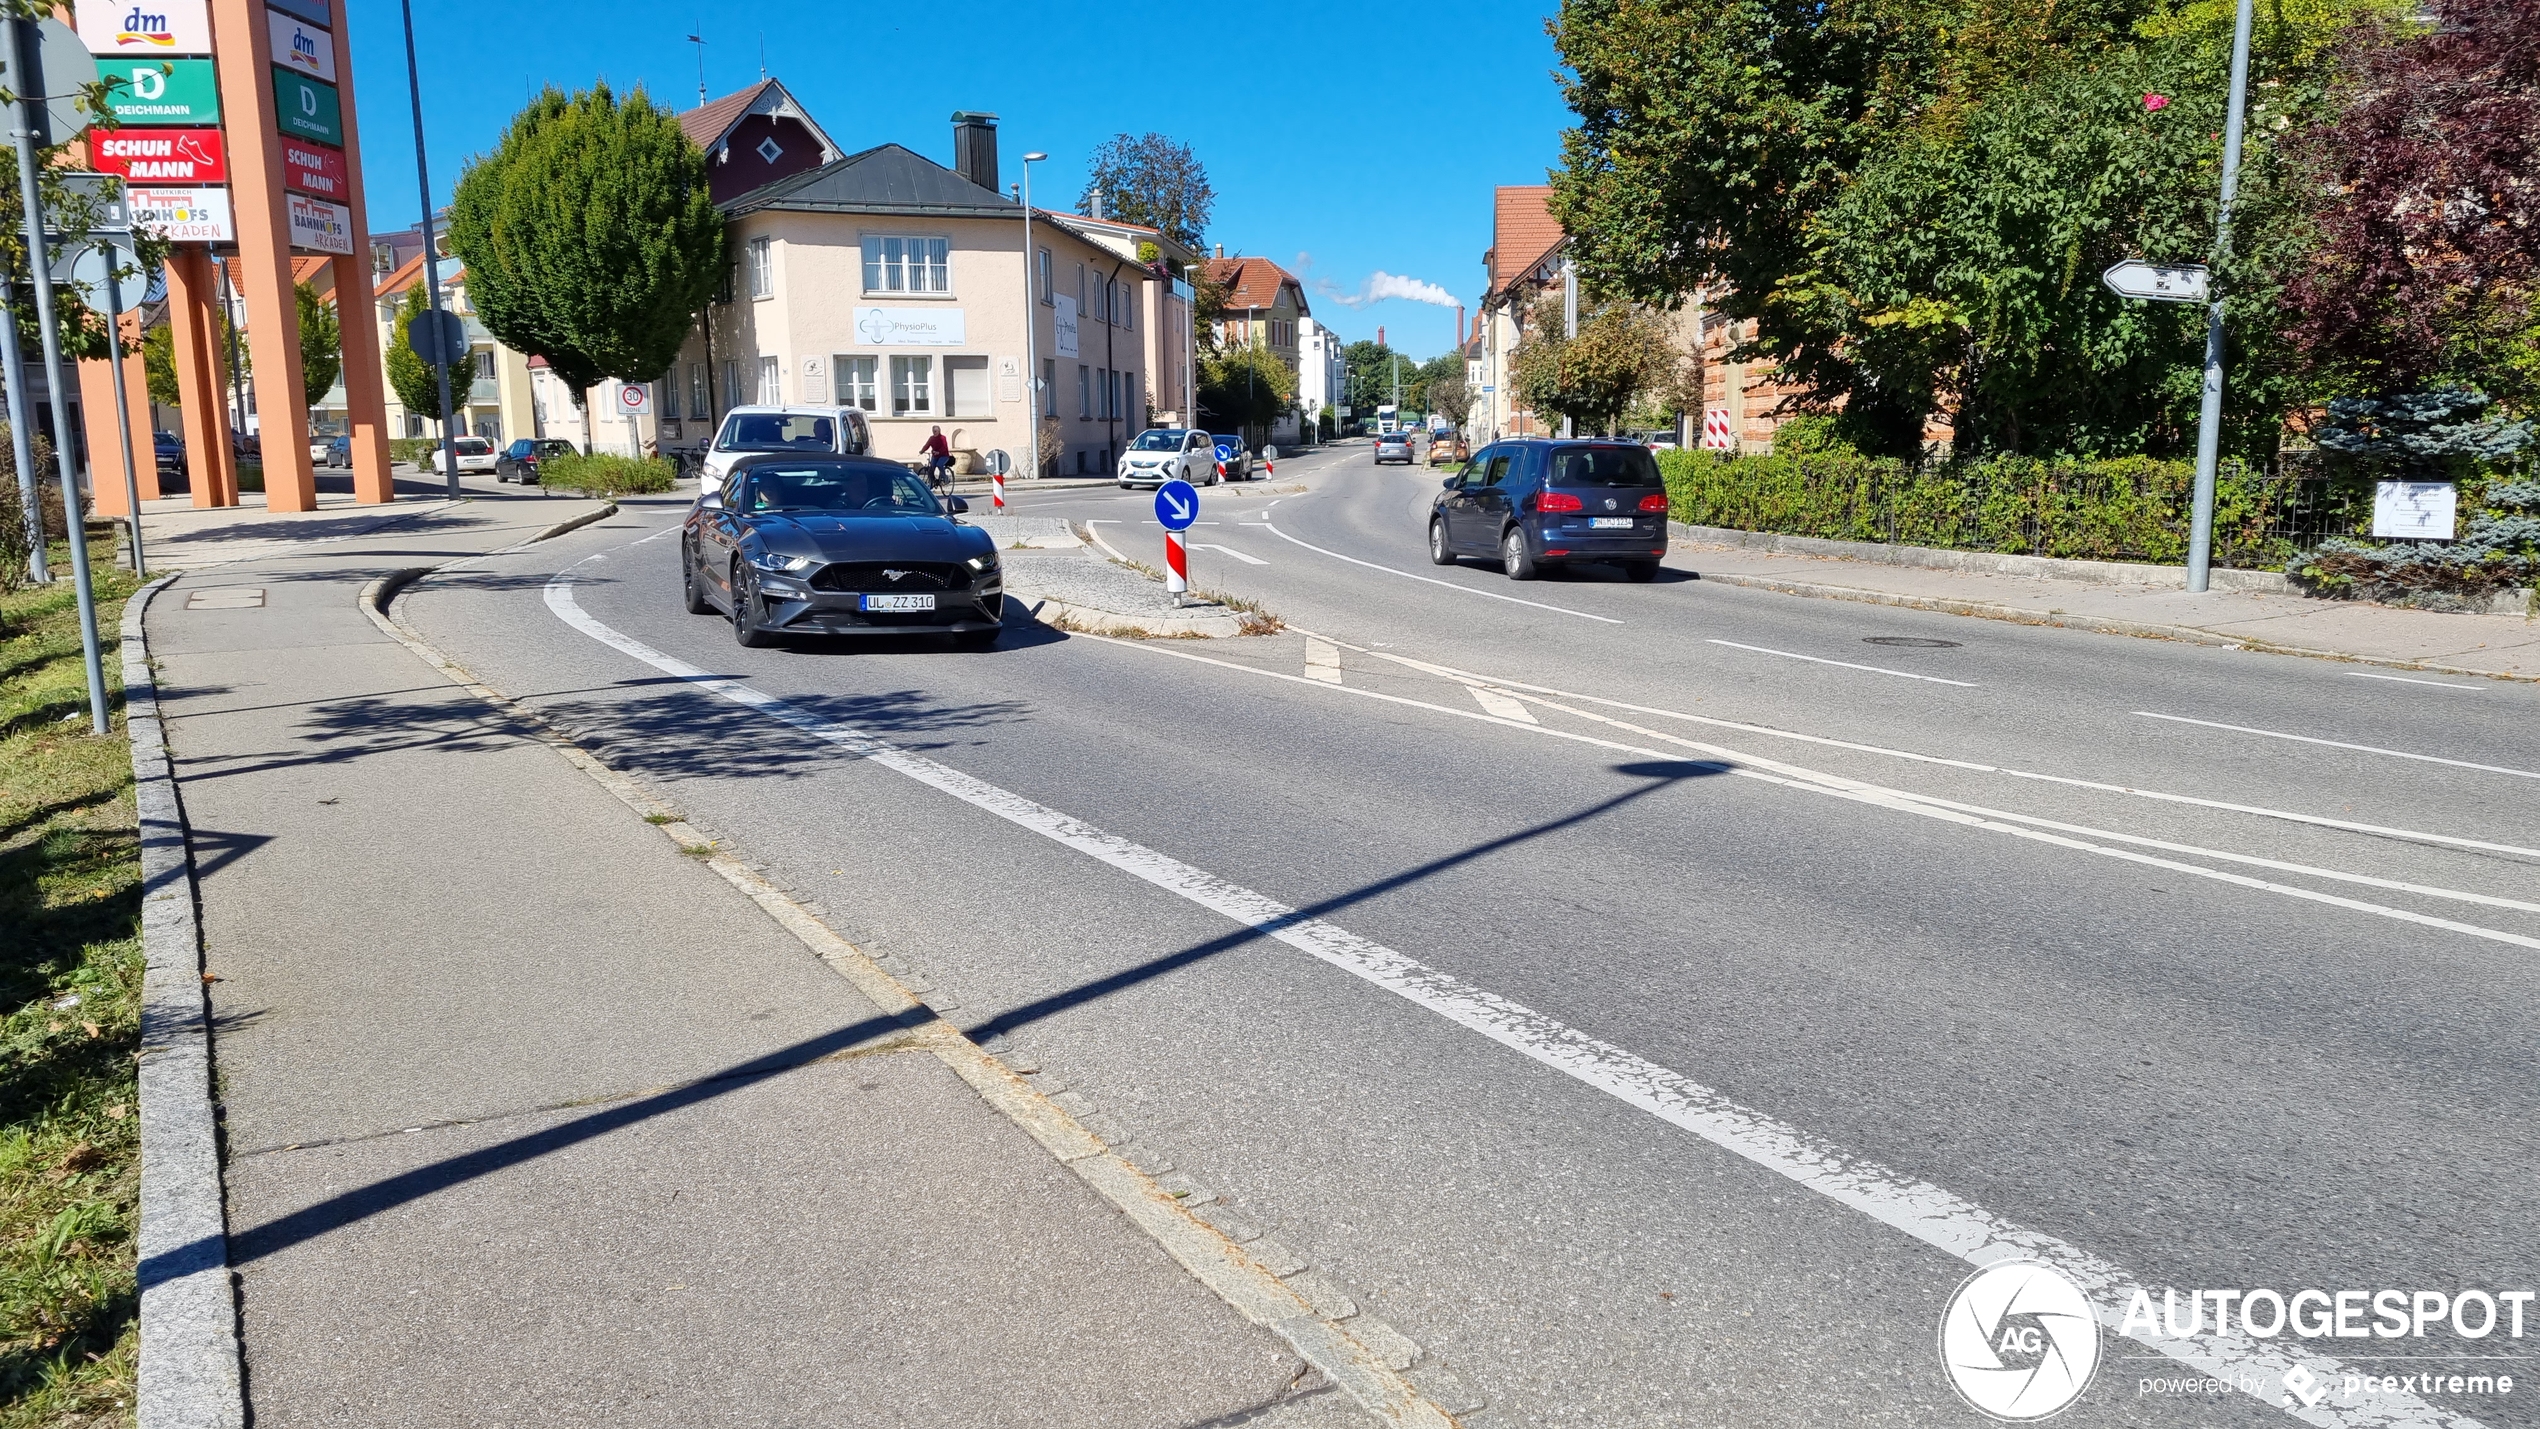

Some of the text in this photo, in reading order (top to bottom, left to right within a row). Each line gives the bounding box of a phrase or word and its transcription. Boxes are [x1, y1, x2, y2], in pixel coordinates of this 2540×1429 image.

[124, 7, 167, 32] dm
[293, 26, 314, 56] dm
[132, 67, 165, 100] D
[115, 105, 190, 115] DEICHMANN
[300, 85, 317, 116] D
[293, 117, 329, 135] DEICHMANN
[102, 140, 172, 156] SCHUH
[129, 161, 194, 178] MANN
[288, 148, 322, 171] SCHUH
[303, 172, 333, 193] MANN
[294, 214, 342, 235] BAHNHOFS
[315, 232, 349, 252] ARKADEN
[894, 322, 937, 332] PhysioPlus
[626, 391, 639, 401] 30
[868, 597, 933, 608] UL ZZ 310
